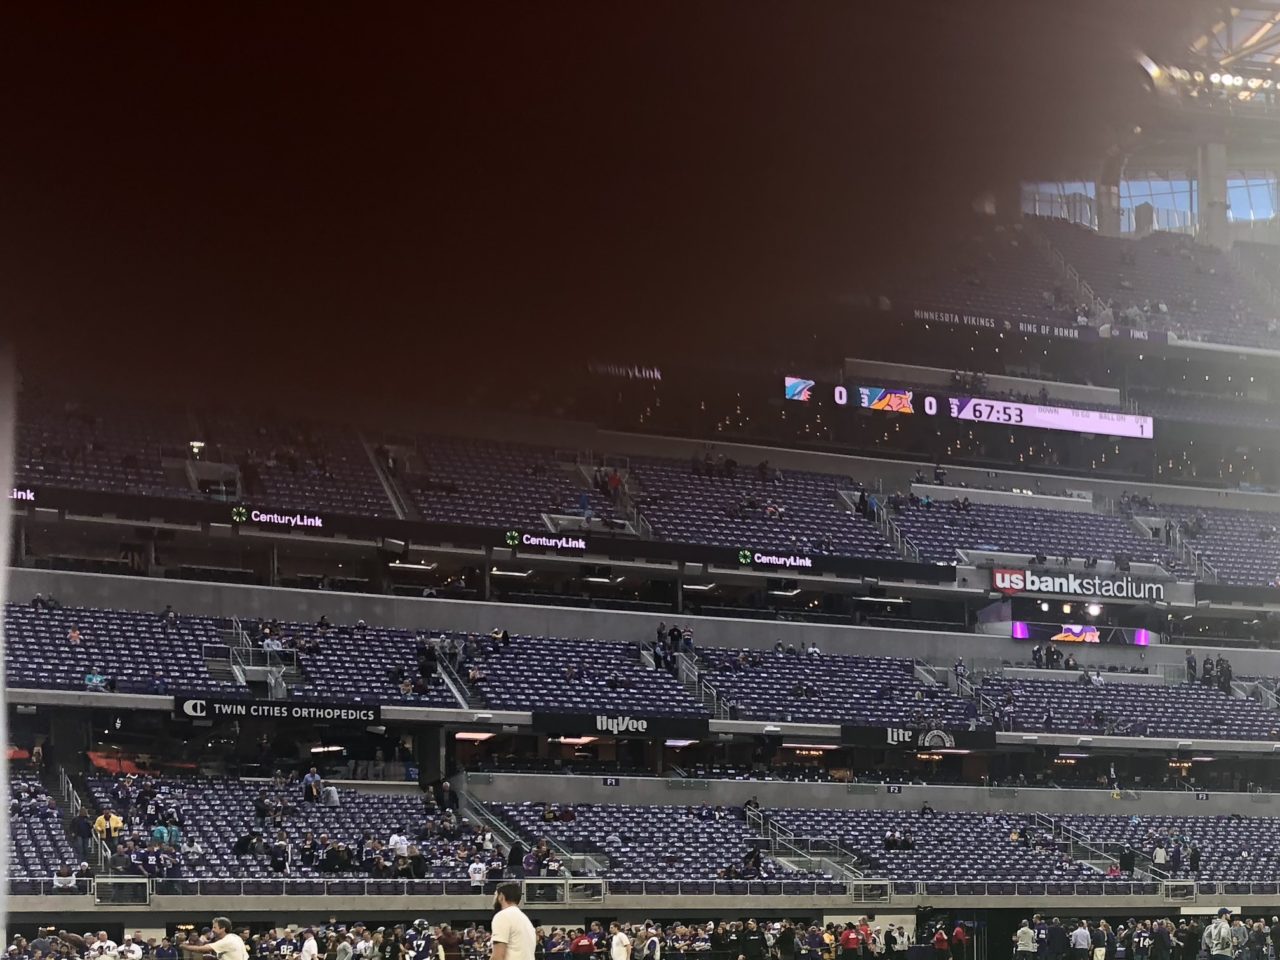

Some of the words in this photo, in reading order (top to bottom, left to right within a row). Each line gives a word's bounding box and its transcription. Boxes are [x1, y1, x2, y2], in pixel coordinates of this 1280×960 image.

[914, 309, 959, 324] MINNESOTA
[963, 316, 995, 328] VIKINGS
[1019, 322, 1037, 334] RING
[1041, 325, 1050, 335] OF
[1054, 327, 1079, 339] HONOR
[1130, 329, 1149, 340] FINKS
[834, 386, 847, 405] 0
[860, 394, 869, 407] 3
[924, 396, 937, 415] 0
[950, 404, 958, 418] 3
[972, 402, 1024, 423] 67:53
[251, 510, 323, 527] CenturyLink
[522, 533, 586, 549] CenturyLink
[754, 553, 812, 567] CenturyLink
[214, 703, 246, 715] TWIN
[251, 705, 288, 717] CITIES
[292, 707, 375, 720] ORTHOPEDICS
[887, 727, 912, 744] Lite
[280, 945, 294, 955] 82
[413, 940, 425, 952] 17
[1139, 938, 1149, 948] 14
